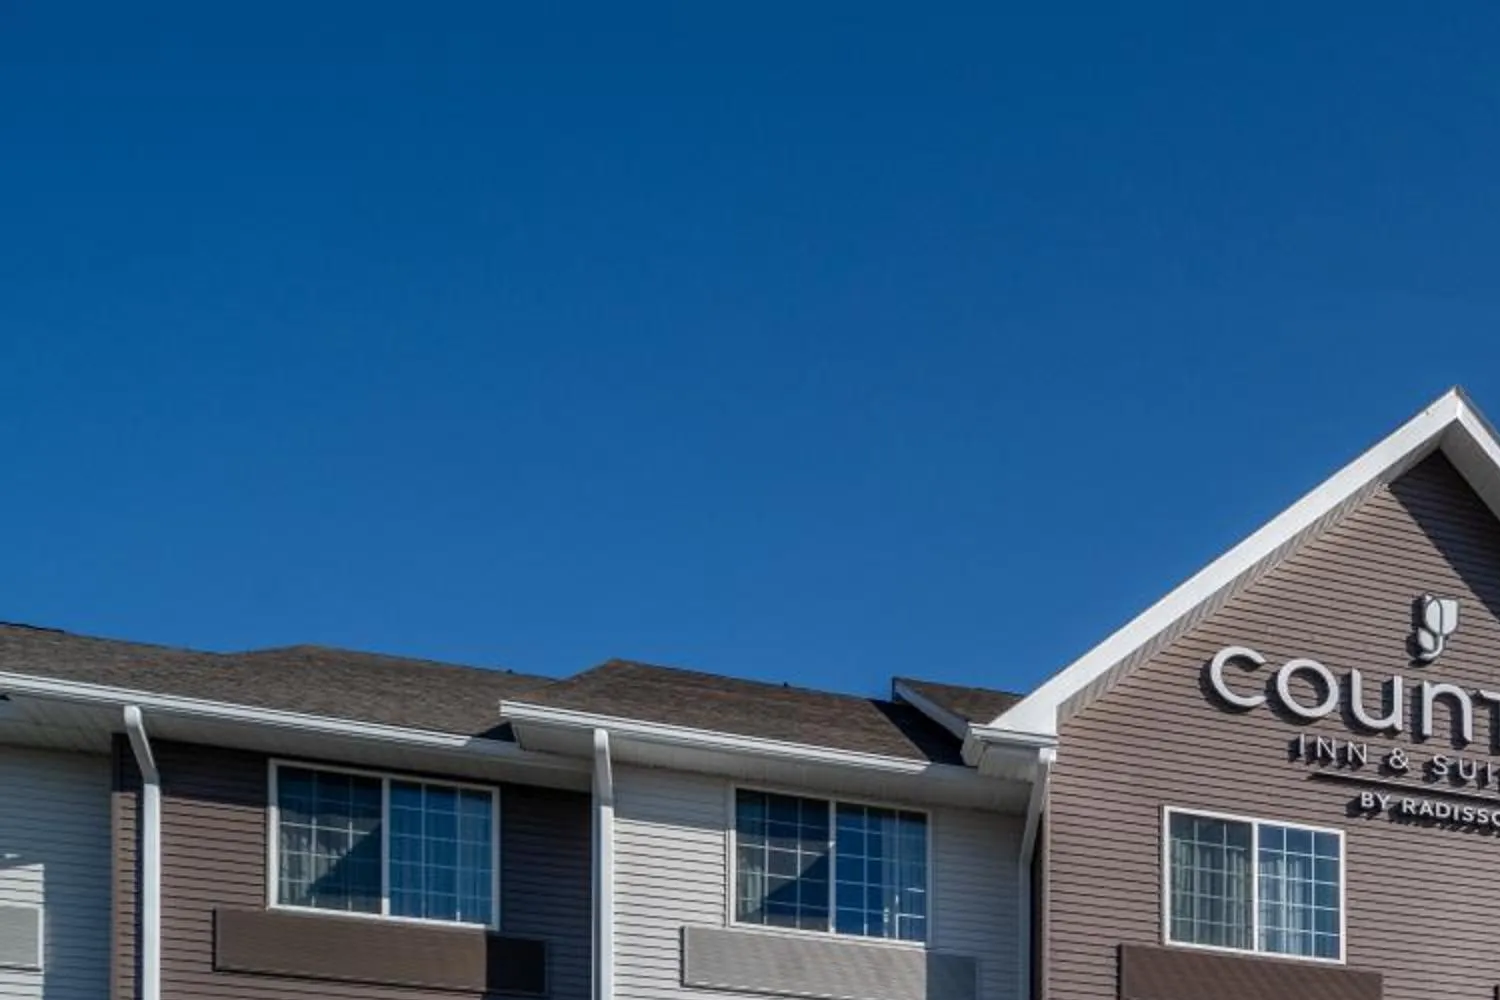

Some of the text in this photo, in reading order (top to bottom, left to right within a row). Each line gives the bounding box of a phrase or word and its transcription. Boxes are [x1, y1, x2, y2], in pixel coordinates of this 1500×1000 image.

[1299, 733, 1369, 765] INN
[1389, 747, 1410, 769] &
[1360, 792, 1391, 810] BY
